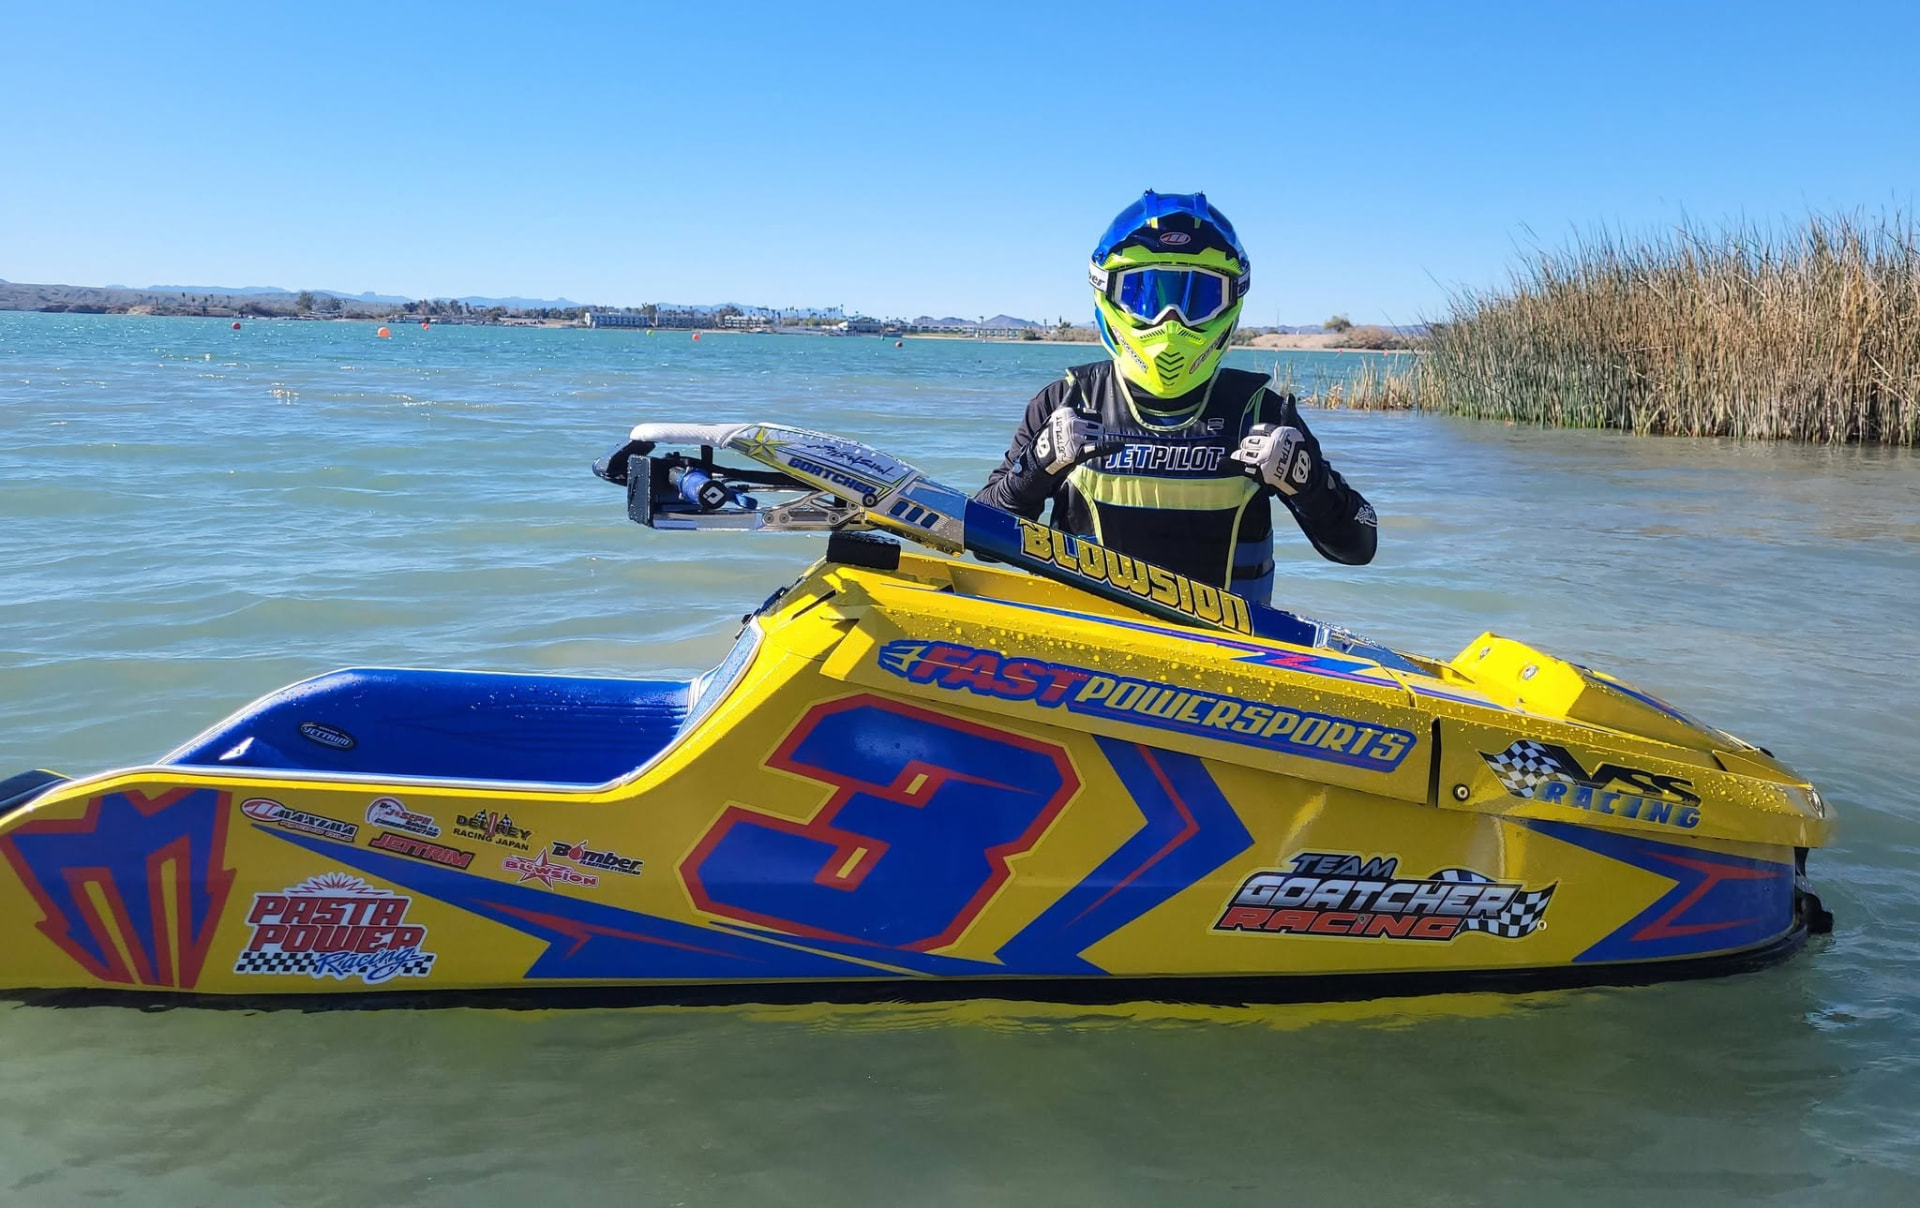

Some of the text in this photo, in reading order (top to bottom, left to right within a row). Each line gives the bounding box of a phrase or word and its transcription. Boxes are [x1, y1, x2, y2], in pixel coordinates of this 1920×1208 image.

[1105, 443, 1225, 471] JETPILOT
[1018, 516, 1255, 637] BLOWSION
[912, 646, 1414, 761] FAST POWERSPORTS
[1544, 782, 1701, 829] RACING
[453, 828, 529, 851] RACING JAPAN
[1295, 854, 1397, 878] TEAM
[248, 895, 410, 926] PASTA
[1234, 873, 1522, 917] GOATCHER
[248, 924, 426, 953] POWER
[1219, 906, 1464, 939] RACING
[315, 947, 426, 981] Racing
